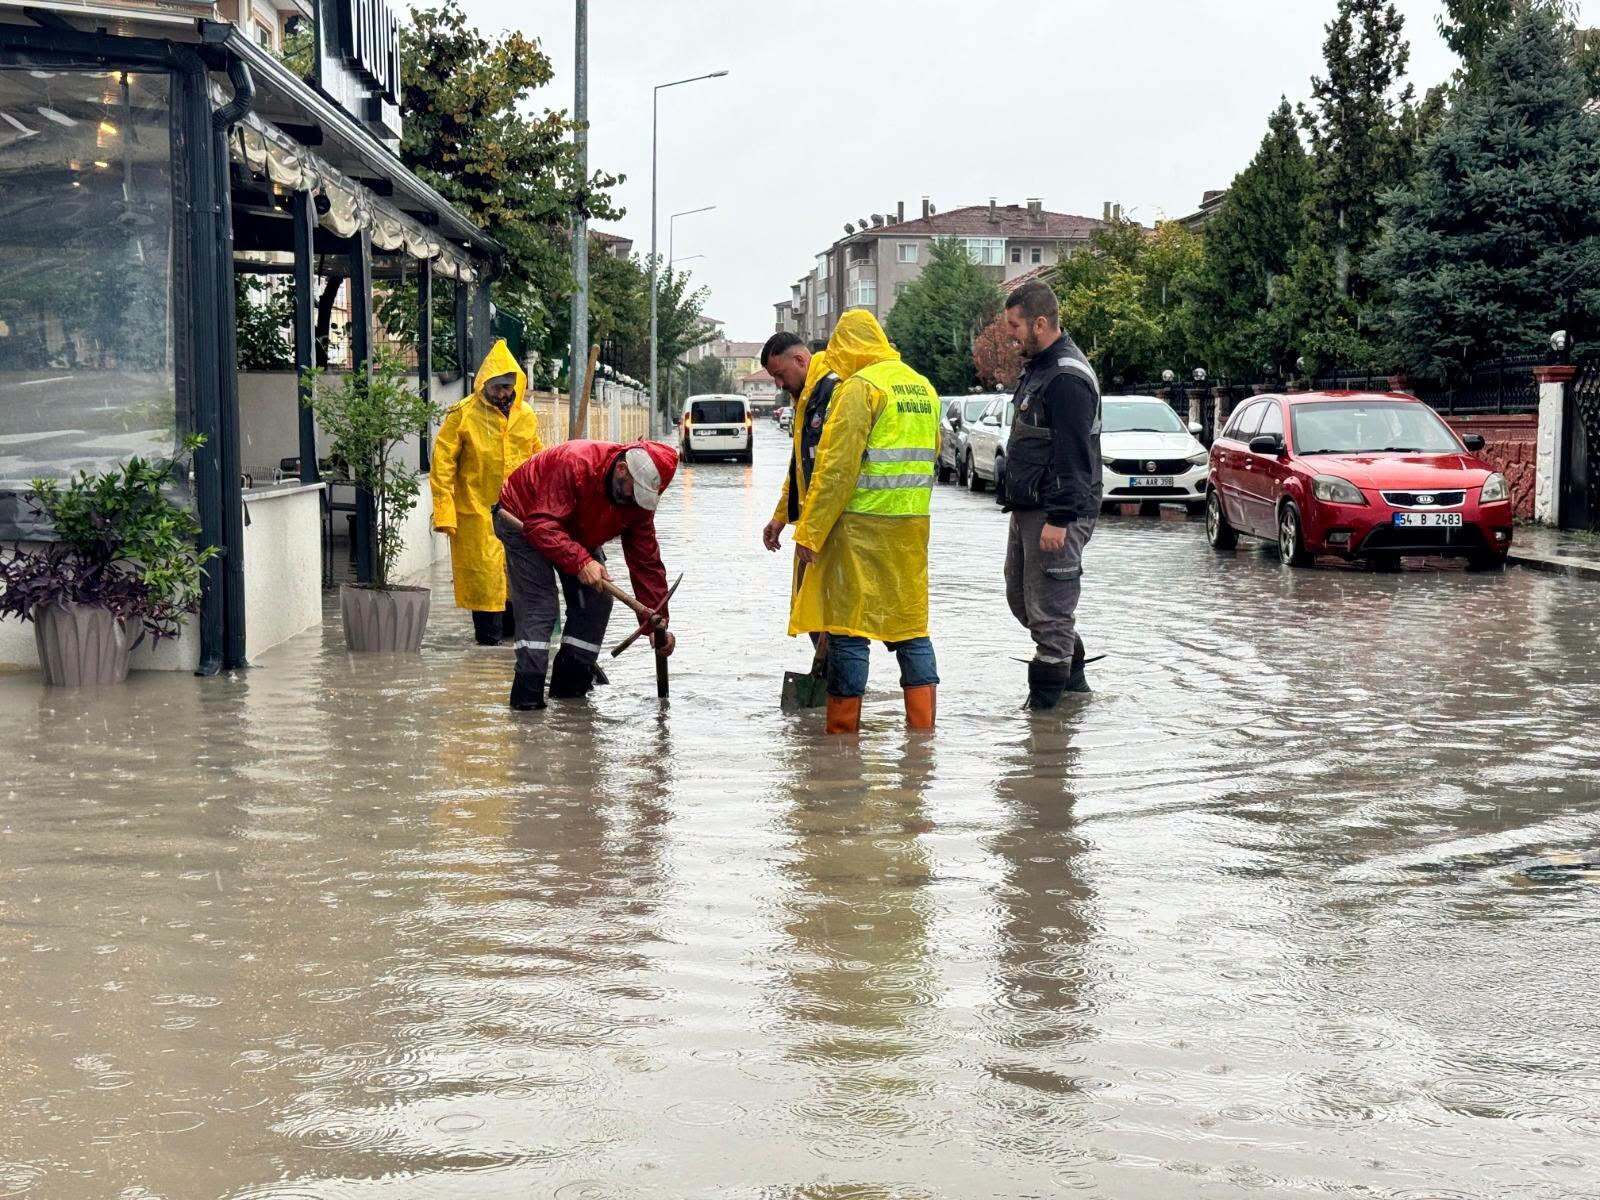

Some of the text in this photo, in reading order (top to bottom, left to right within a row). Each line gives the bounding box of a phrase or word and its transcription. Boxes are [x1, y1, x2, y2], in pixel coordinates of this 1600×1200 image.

[1401, 514, 1460, 525] 54 B 2483
